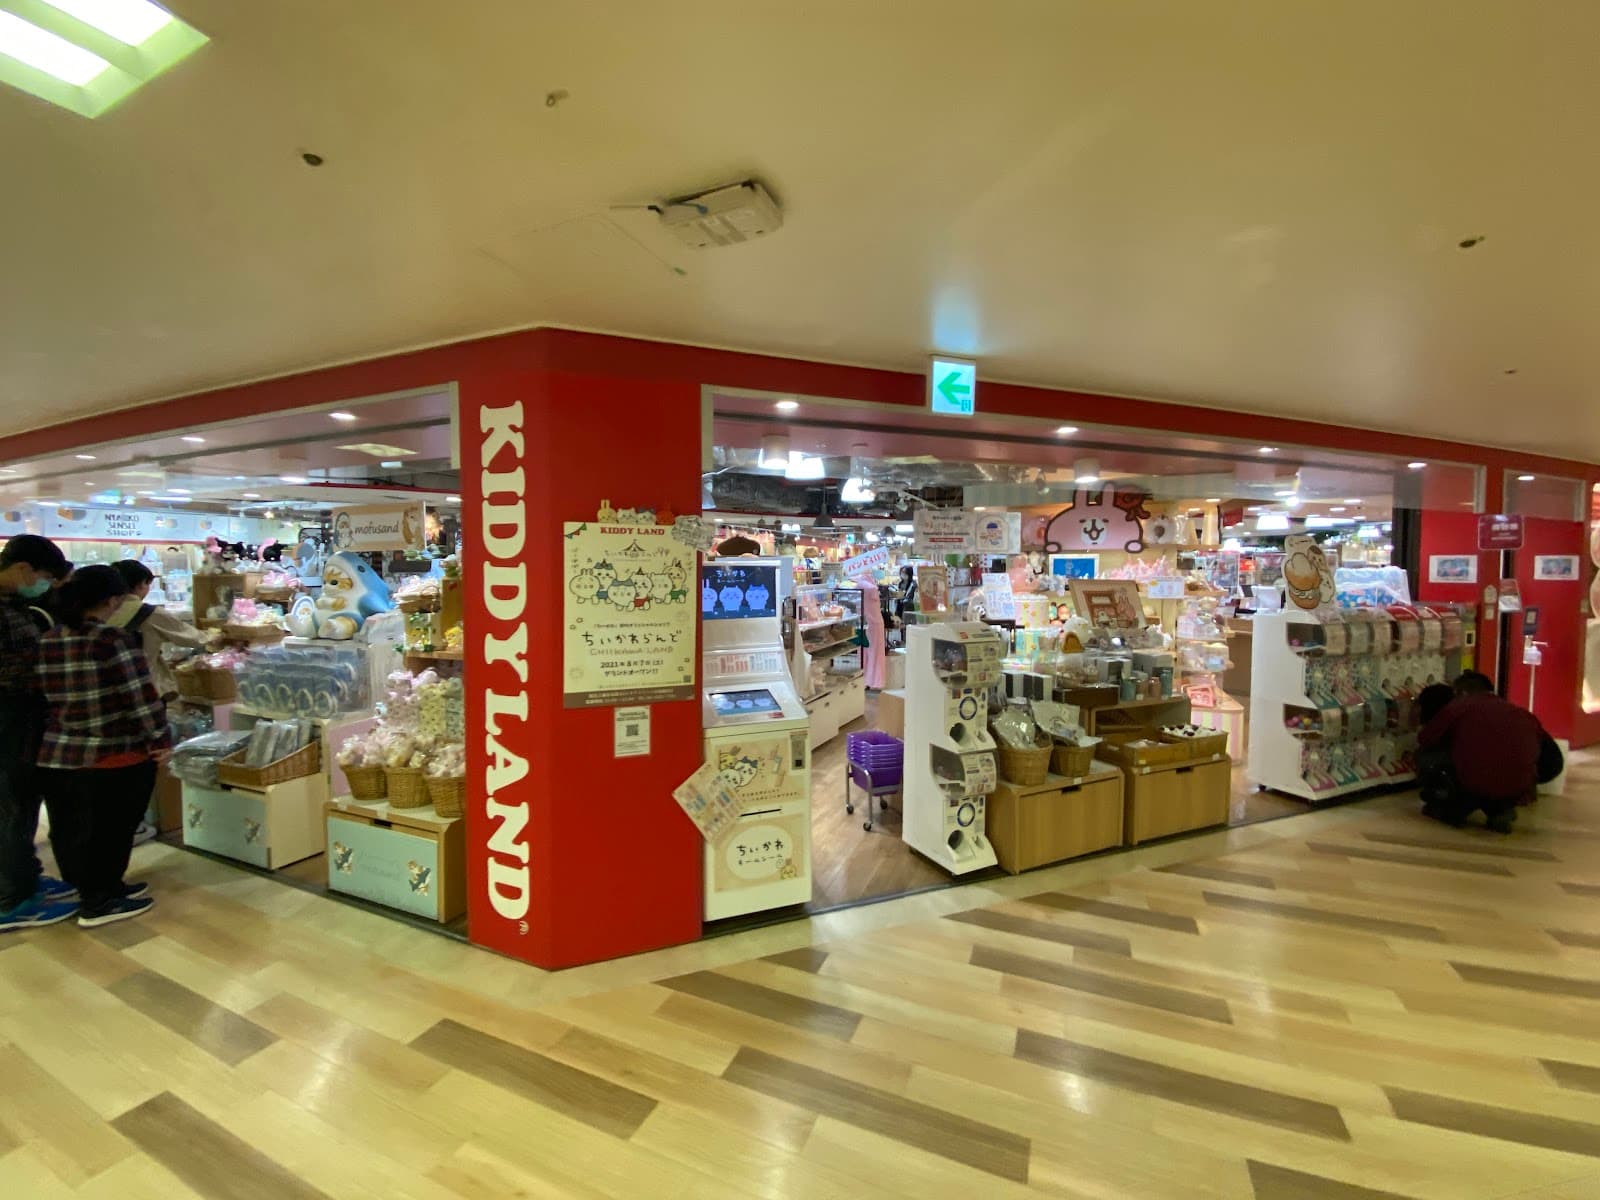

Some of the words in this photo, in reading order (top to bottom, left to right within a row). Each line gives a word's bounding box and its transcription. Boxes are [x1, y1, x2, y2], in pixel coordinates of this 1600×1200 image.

[354, 521, 400, 535] mofusand
[581, 630, 682, 646] ちいかわらんど
[736, 838, 784, 856] ちいかわ
